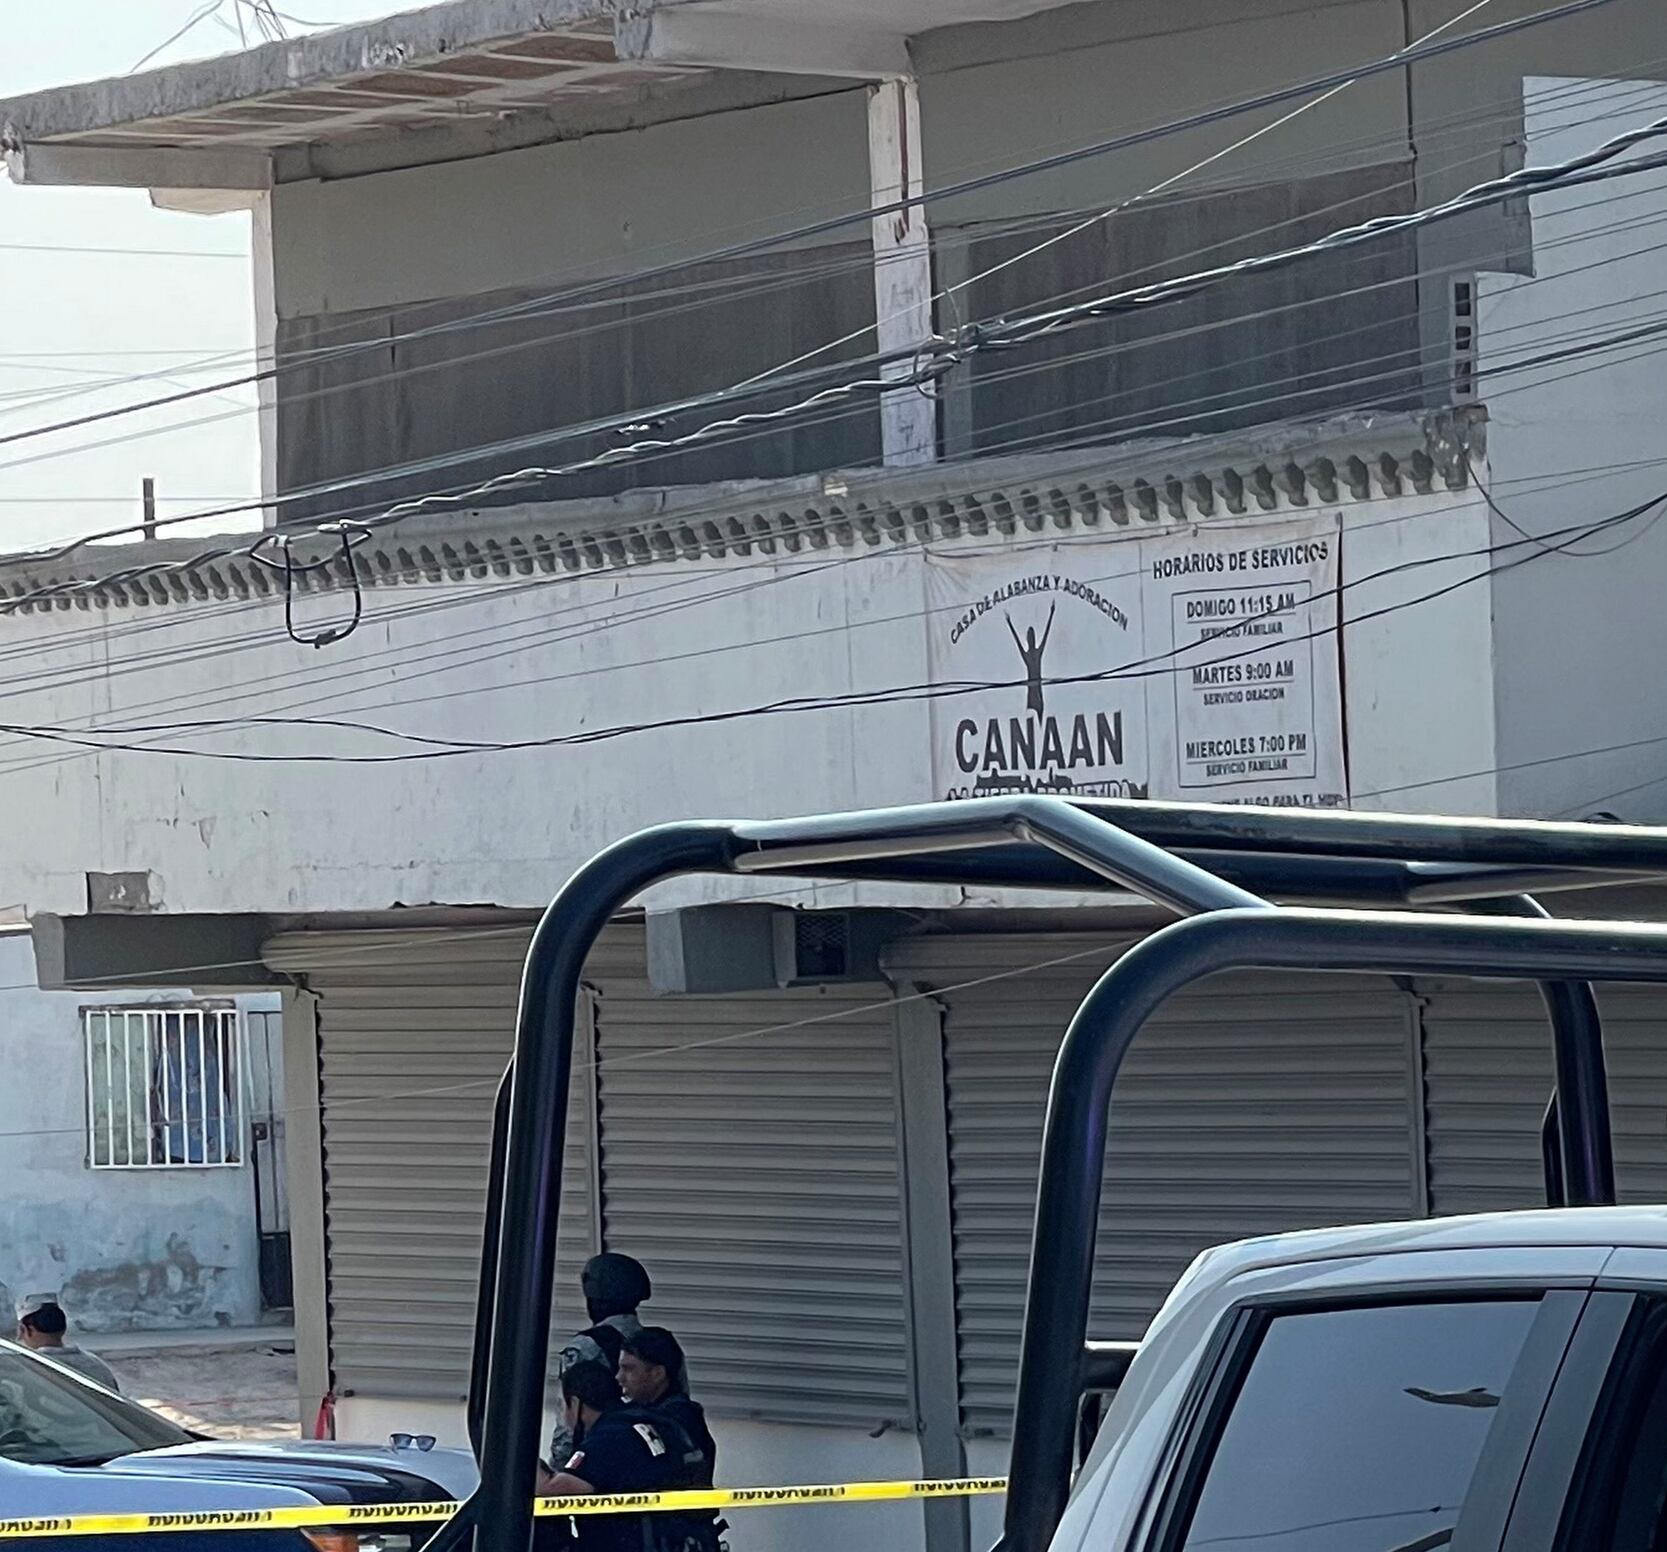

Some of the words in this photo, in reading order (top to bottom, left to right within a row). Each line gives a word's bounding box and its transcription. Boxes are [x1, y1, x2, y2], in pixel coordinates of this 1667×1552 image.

[1153, 552, 1224, 579] HORARIOS
[1229, 550, 1247, 571] DE
[1251, 541, 1329, 570] SERVICIOS
[951, 608, 976, 644] CASA
[976, 595, 993, 617] DE
[992, 575, 1050, 605] ALABANZA
[1052, 574, 1061, 590] Y
[1063, 578, 1129, 632] ADORACION
[1187, 598, 1236, 619] DOMIGO
[1240, 595, 1273, 614] 11:15
[1276, 592, 1296, 611] AM
[1242, 622, 1284, 636] FAMILIAR
[1192, 664, 1242, 684] MARTES
[1246, 662, 1272, 681] 9:00
[1275, 660, 1294, 678] AM
[1203, 691, 1243, 706] SERVICIO
[955, 710, 1123, 773] CANAAN
[1186, 736, 1256, 759] MIERCOLES
[1259, 734, 1285, 753] 7:00
[1288, 733, 1307, 751] PM
[1206, 761, 1246, 777] SERVICIO
[1248, 758, 1288, 773] FAMILIAR
